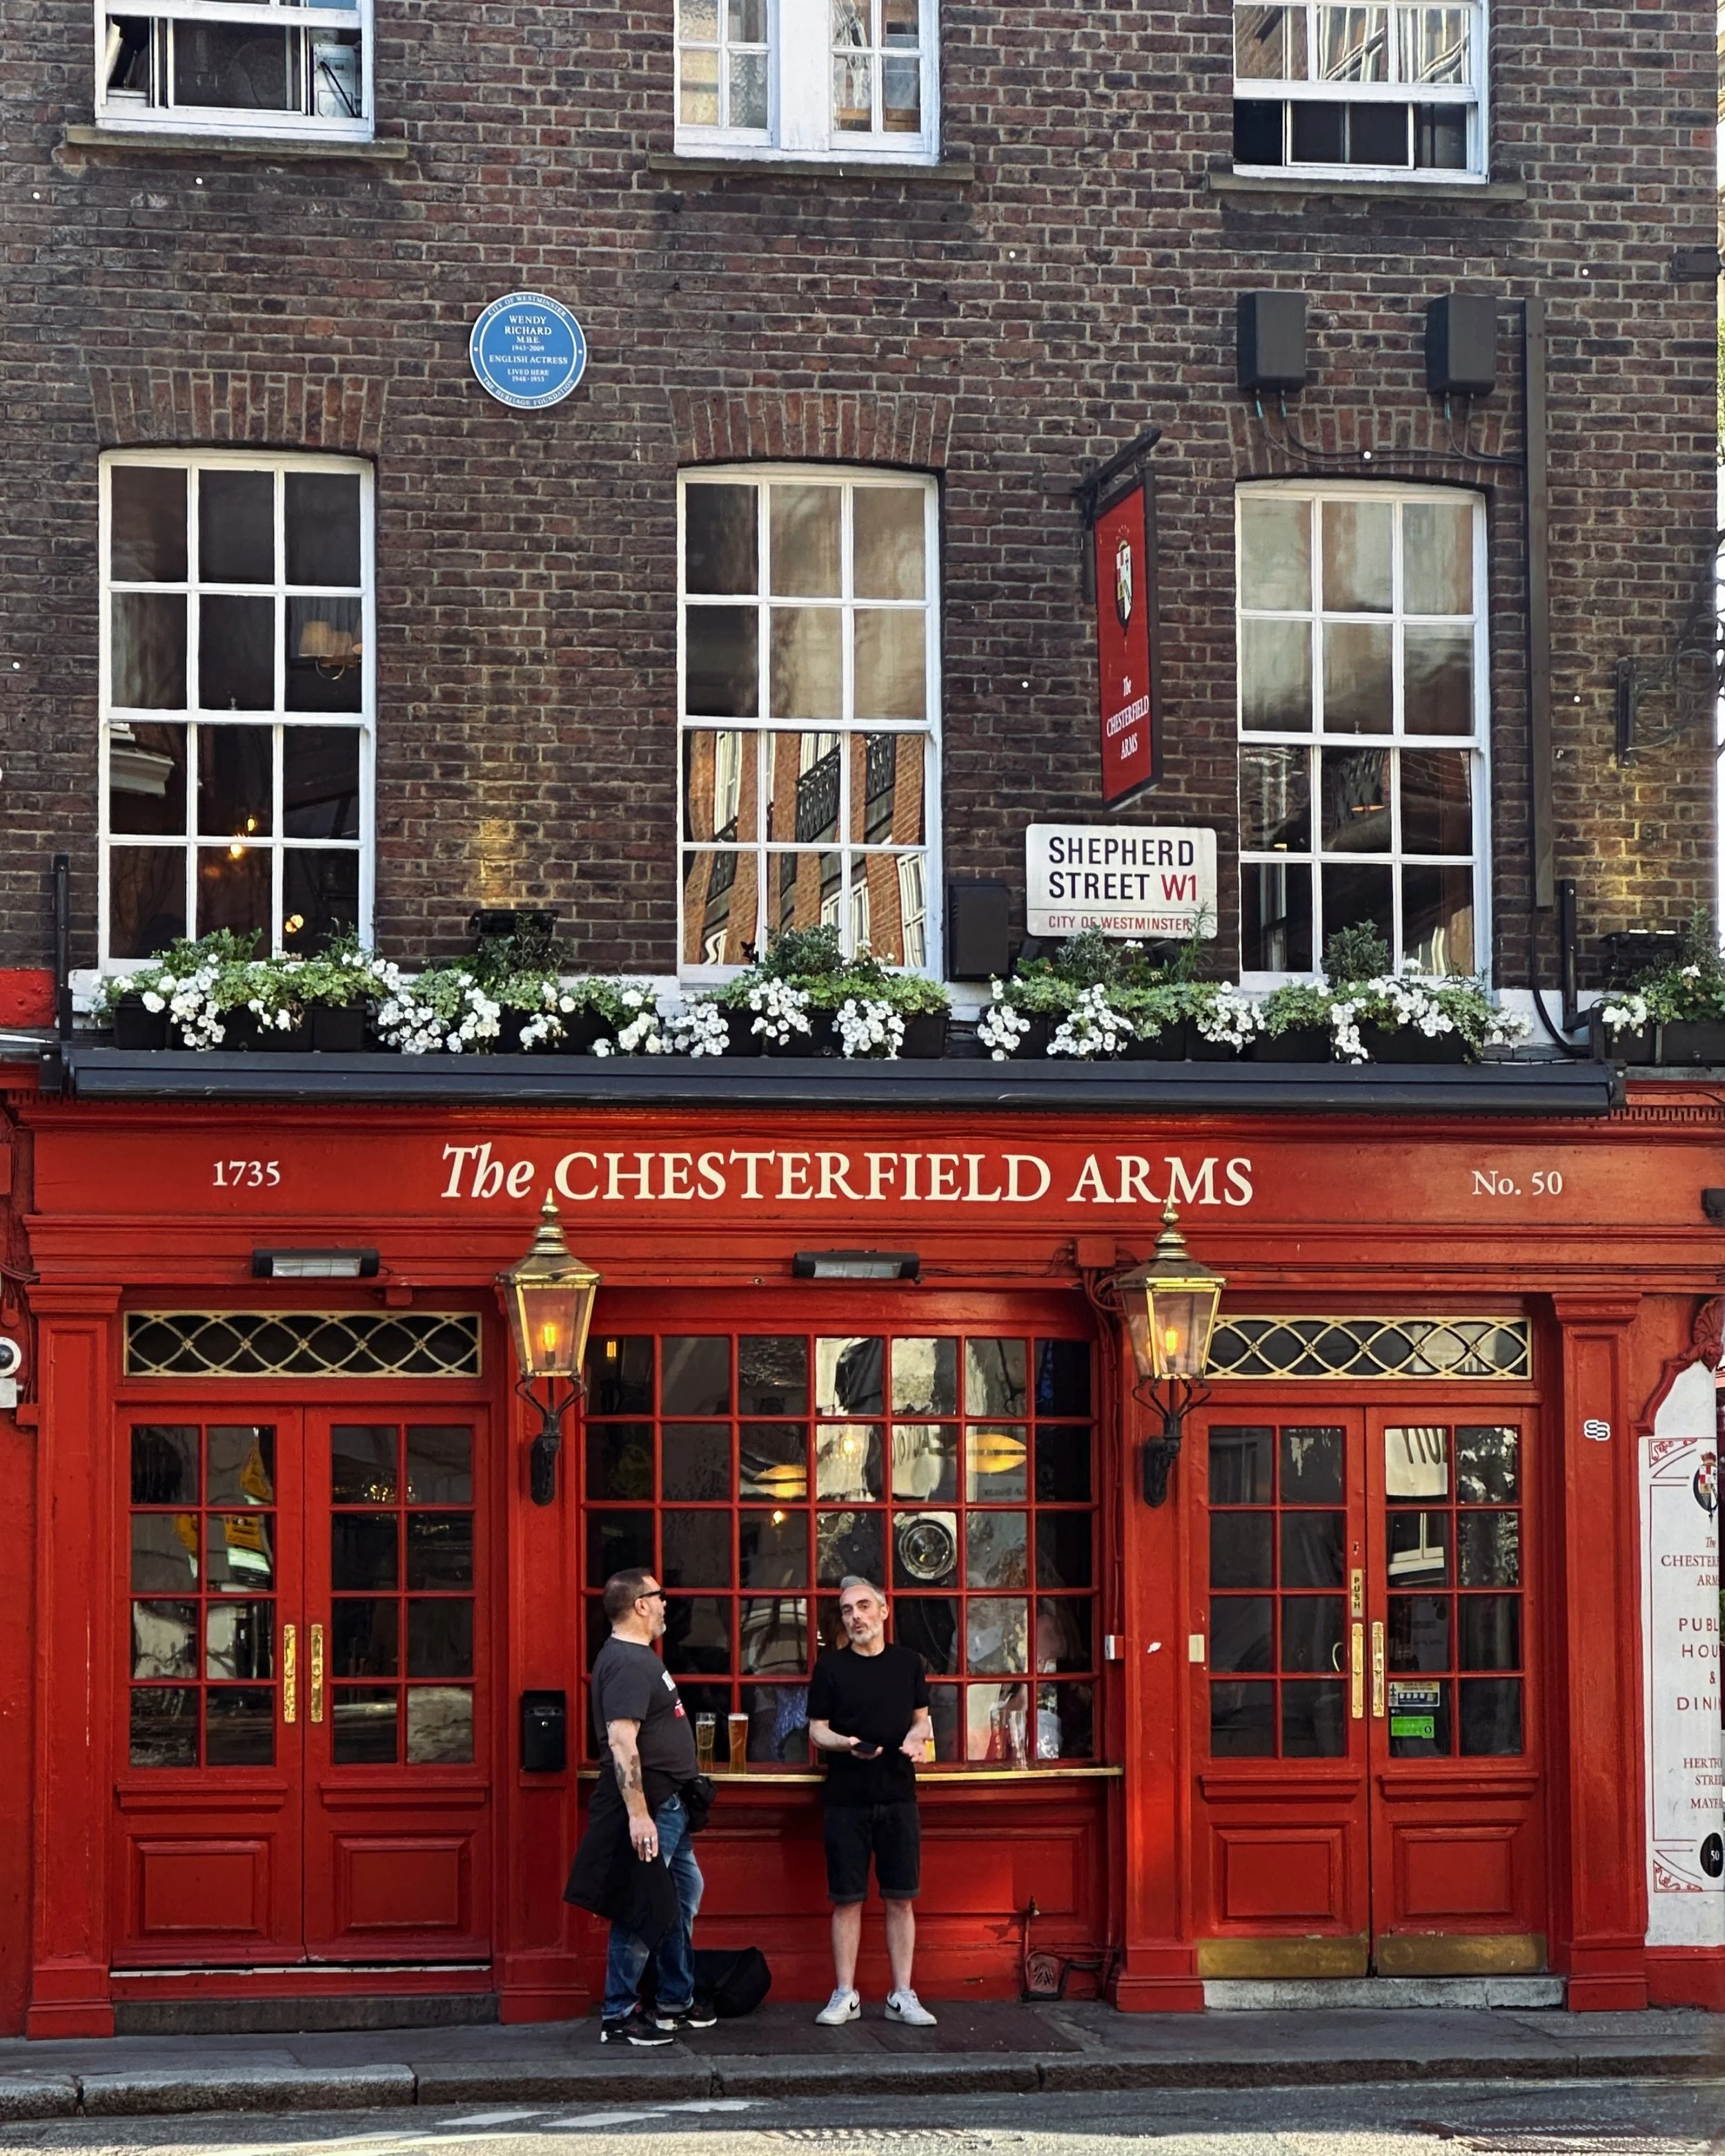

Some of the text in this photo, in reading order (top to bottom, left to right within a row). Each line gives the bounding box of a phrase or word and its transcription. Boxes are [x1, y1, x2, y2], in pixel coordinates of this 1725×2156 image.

[487, 295, 567, 317] CITY OF WESTMINSTER
[504, 326, 552, 335] RICHARD
[509, 315, 546, 325] WENDY
[489, 355, 568, 364] ENGLISH ACTRESS
[482, 375, 574, 406] THE HERITAGE FOUNDATION
[1106, 695, 1150, 738] CHESTERFIELD
[1121, 732, 1138, 760] ARMS
[1049, 836, 1194, 866] SHEPHERD
[1049, 871, 1196, 901] STREET W1
[1049, 916, 1191, 931] CITY OF WESTMINSTER
[213, 1160, 280, 1187] 1735
[441, 1142, 1253, 1205] The CHESTERFIELD ARMS
[1472, 1171, 1563, 1195] No. 50
[1682, 1644, 1717, 1658] HOU
[1710, 1671, 1716, 1684] &
[1677, 1697, 1720, 1710] DINI
[1711, 1850, 1719, 1861] 50
